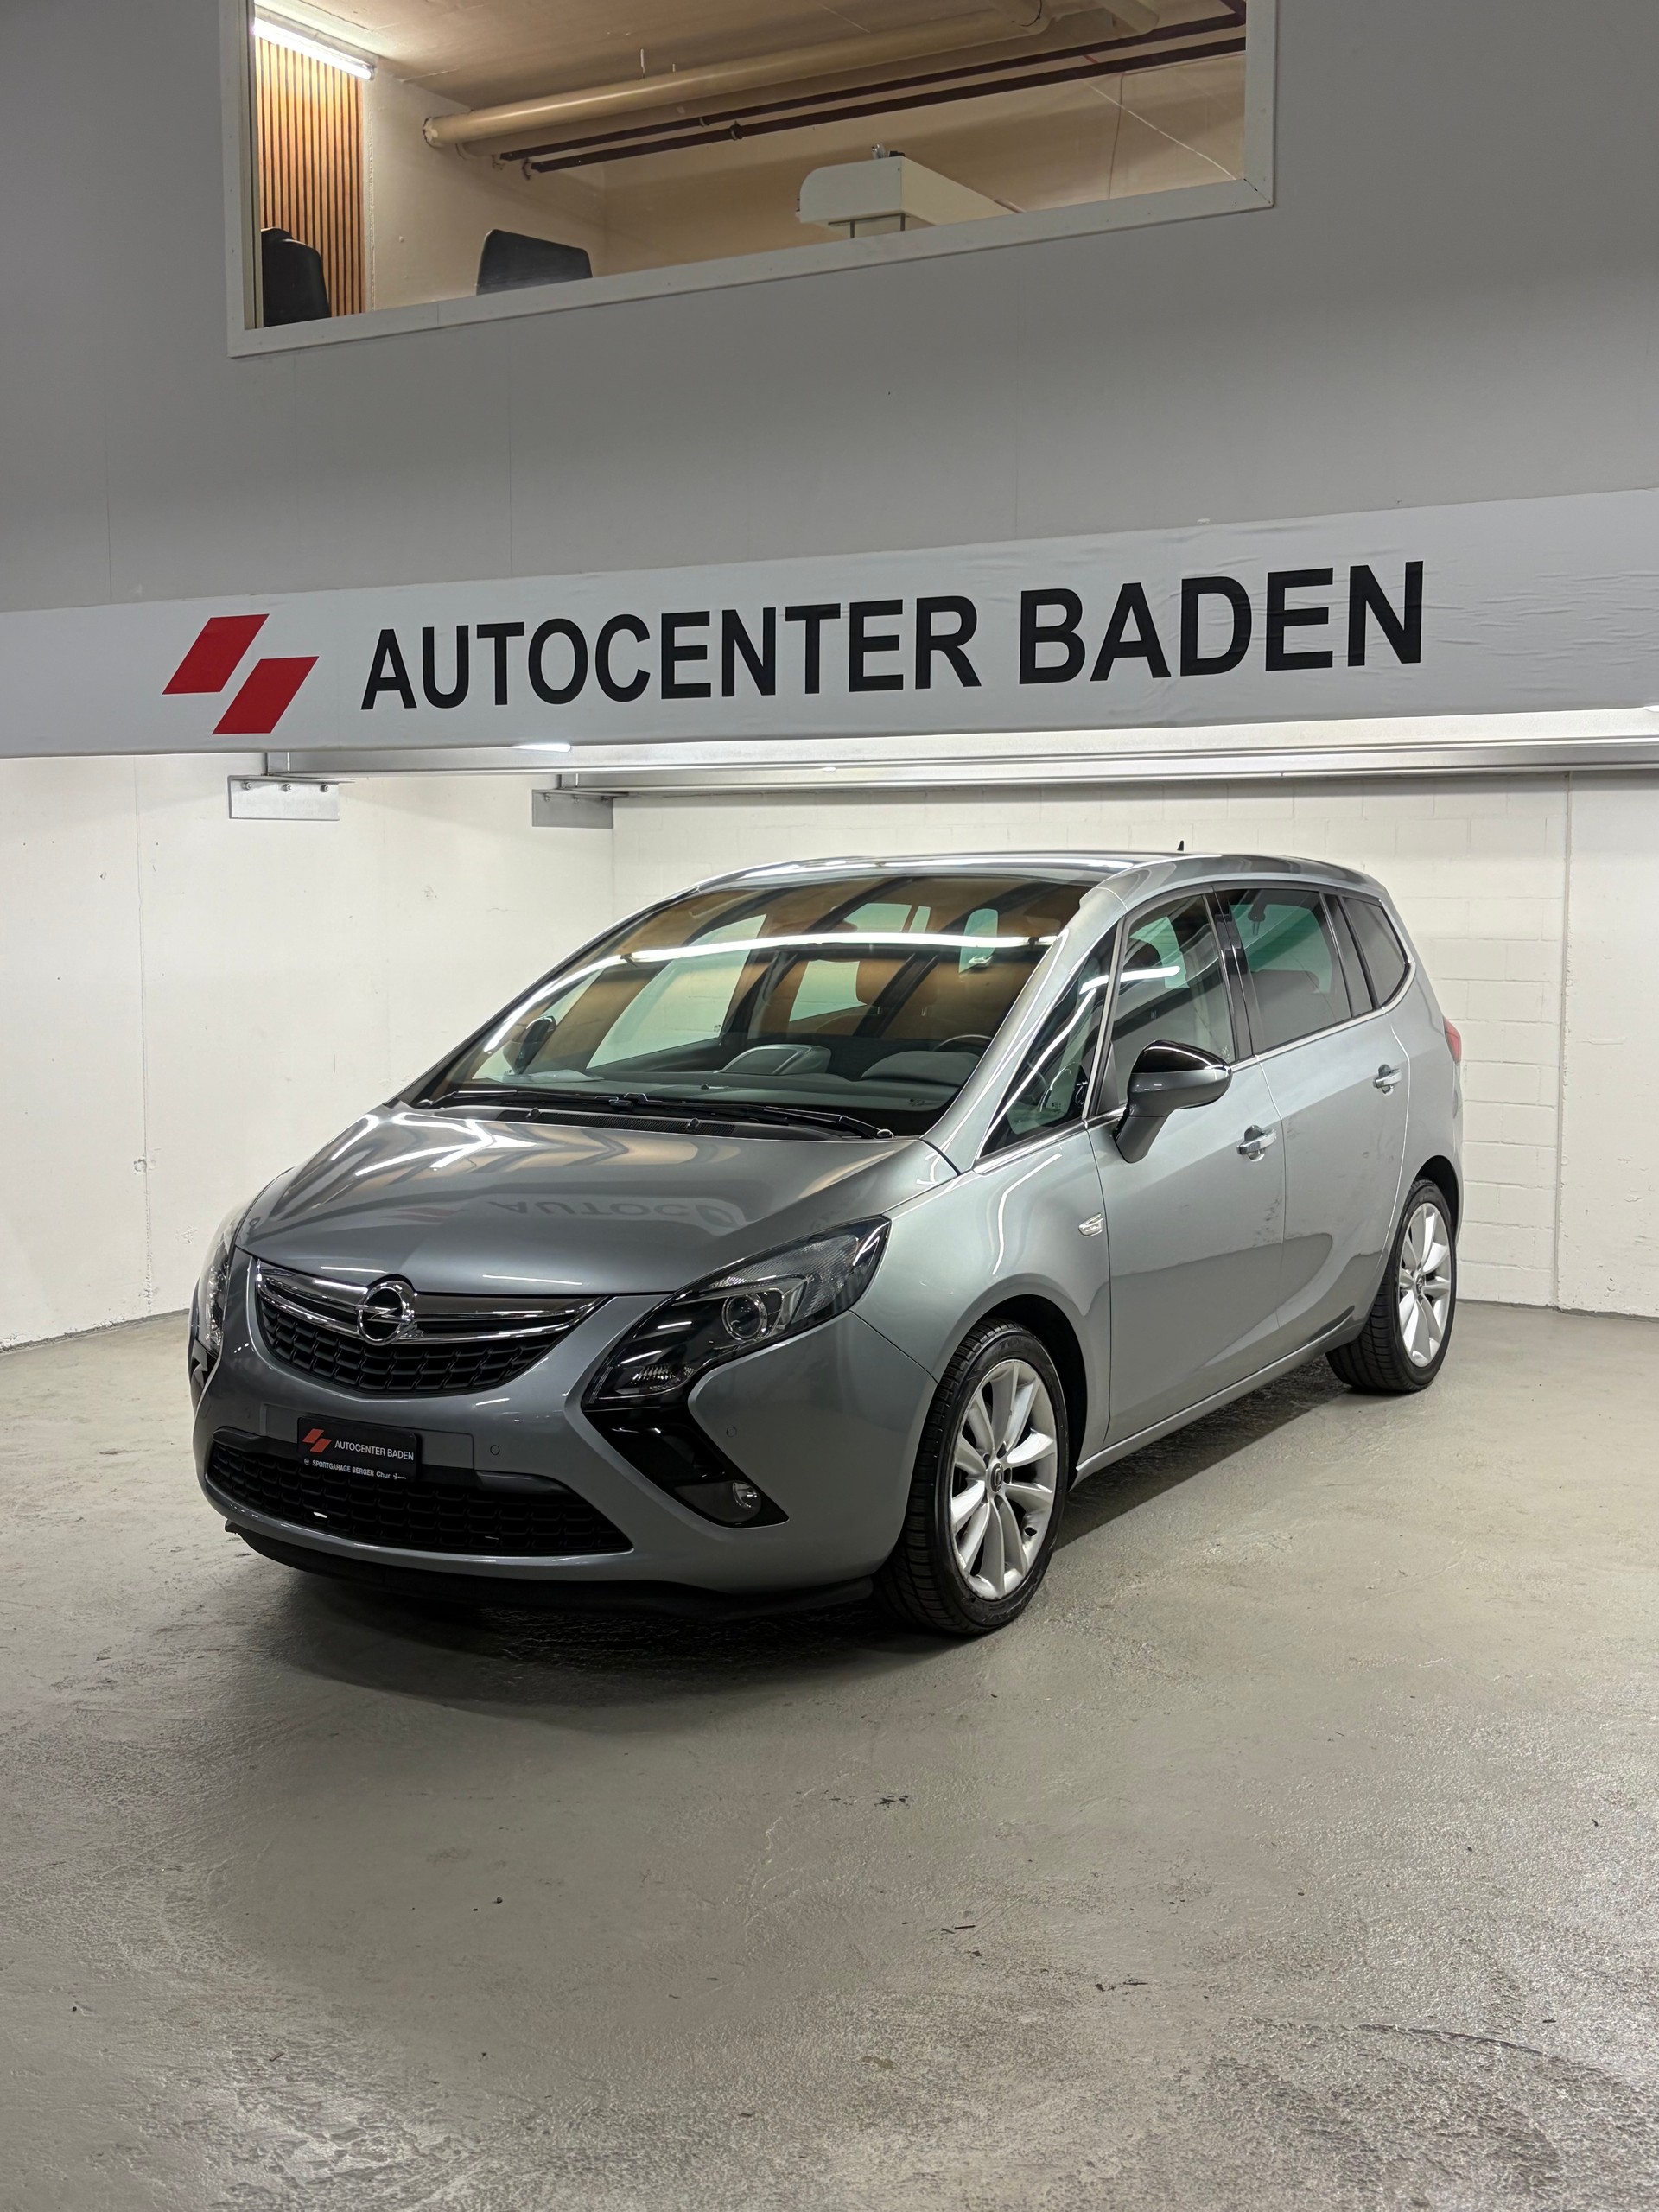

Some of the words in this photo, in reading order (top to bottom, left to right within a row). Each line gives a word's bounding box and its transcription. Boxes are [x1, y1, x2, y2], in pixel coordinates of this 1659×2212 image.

[360, 594, 982, 710] AUTOCENTER
[1019, 560, 1424, 685] BADEN
[334, 1440, 385, 1456] AUTOCENTER
[387, 1448, 414, 1461] BADEN
[312, 1459, 351, 1472] SPORTGARAGE
[352, 1466, 374, 1477] BERGER
[376, 1471, 391, 1479] Chur
